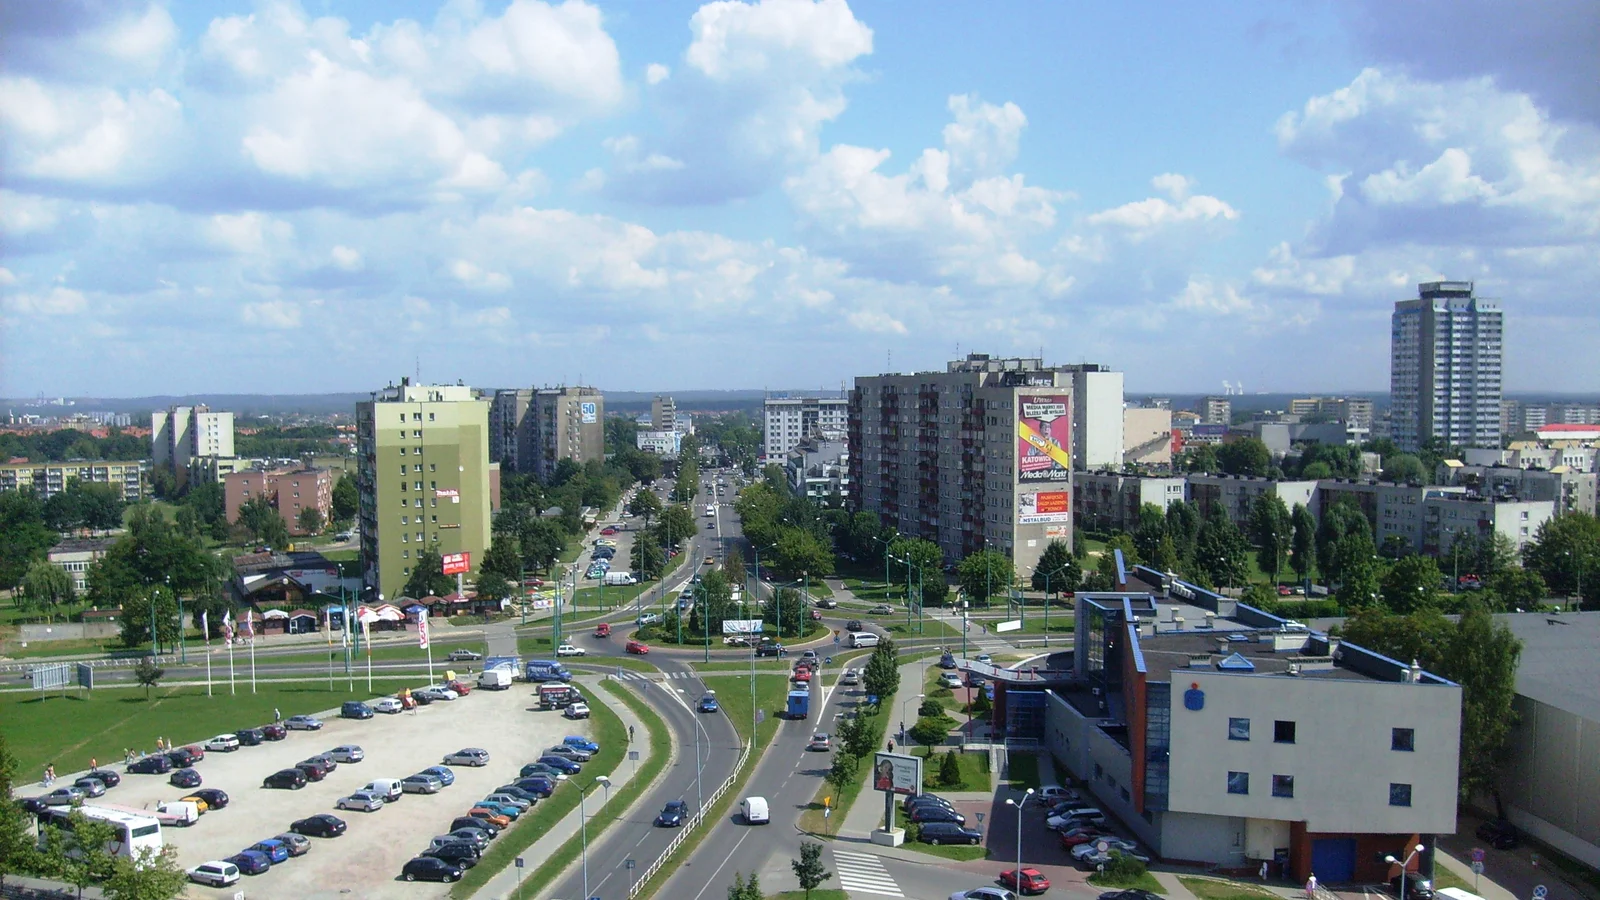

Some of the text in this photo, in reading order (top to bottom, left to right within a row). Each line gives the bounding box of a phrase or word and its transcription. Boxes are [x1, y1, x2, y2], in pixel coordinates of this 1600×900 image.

[582, 403, 595, 414] 50
[1020, 470, 1067, 478] Media Markt
